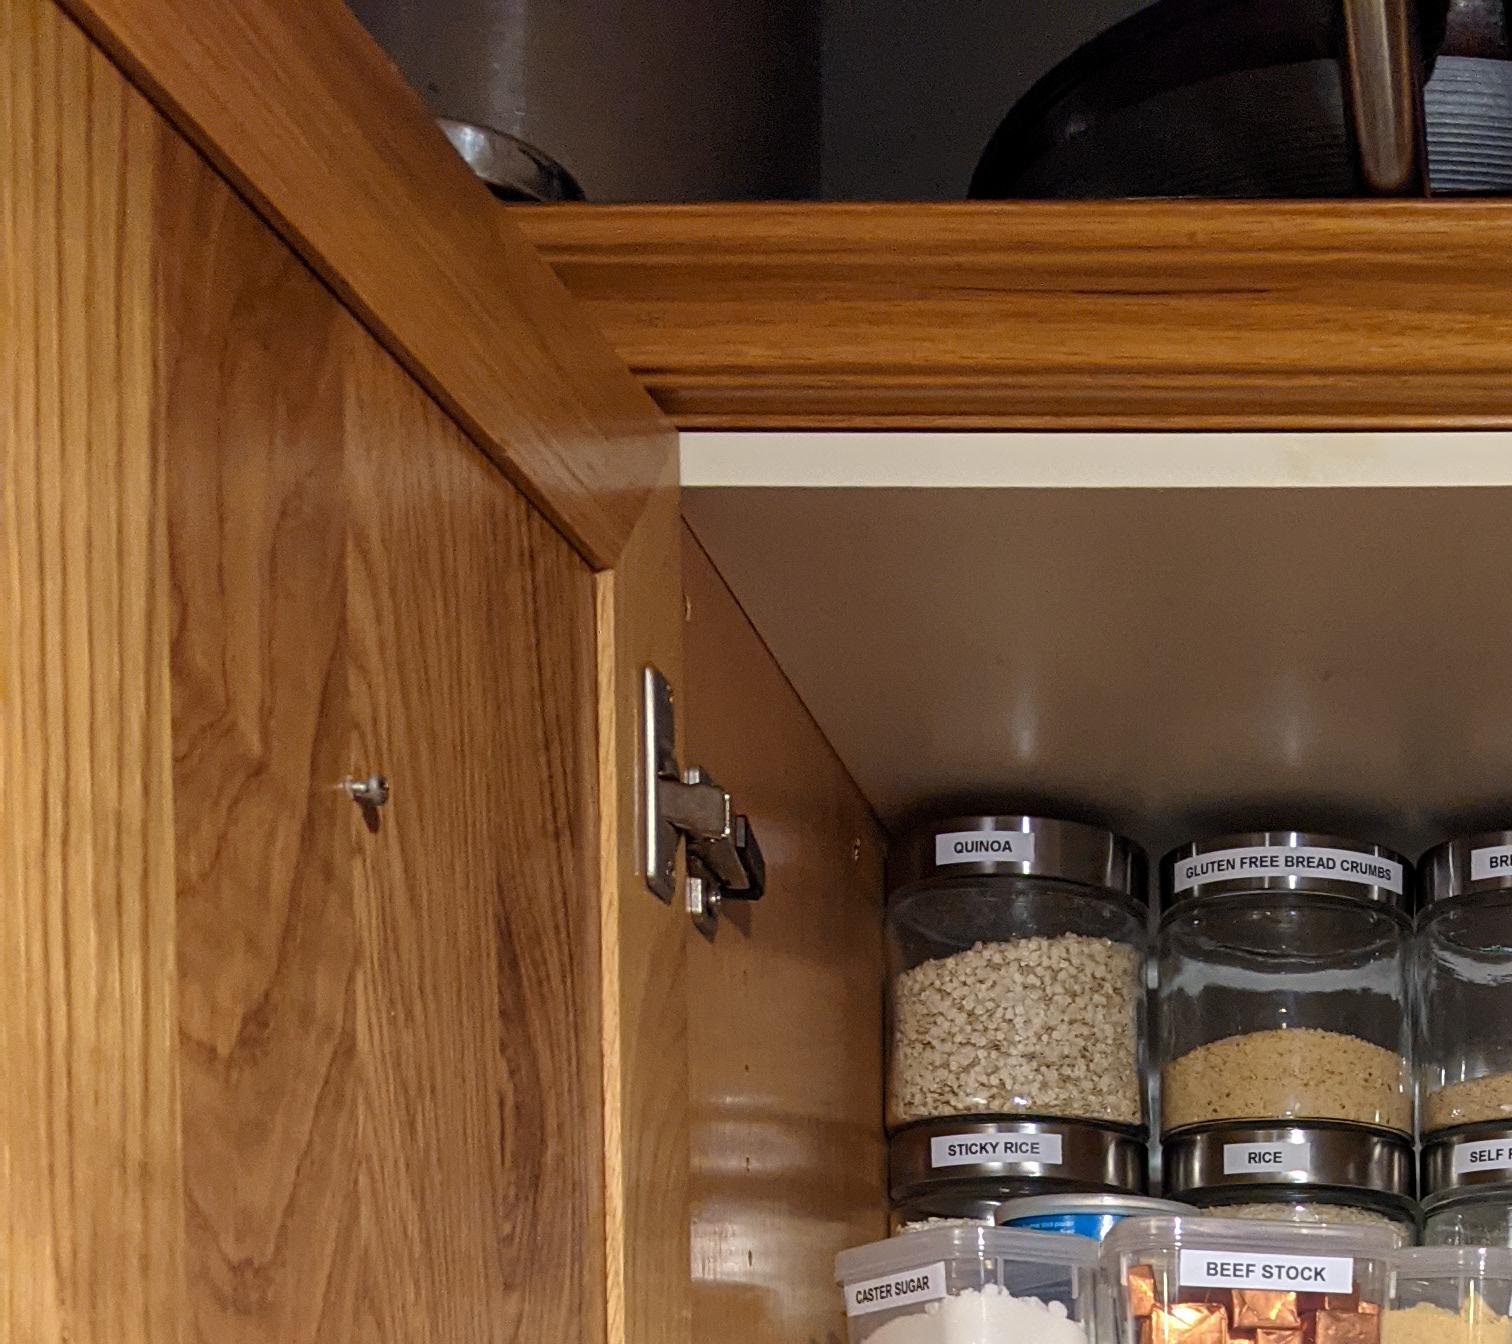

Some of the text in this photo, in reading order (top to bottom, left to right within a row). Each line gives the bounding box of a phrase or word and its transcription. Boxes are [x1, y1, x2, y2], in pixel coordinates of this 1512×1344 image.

[953, 840, 1013, 855] QUINOA
[1185, 855, 1392, 881] GLUTEN FREE BREAD CRUMBS
[948, 1140, 1040, 1157] STICKY RICE
[1469, 1147, 1504, 1163] SELF
[1247, 1151, 1283, 1164] RICE
[1206, 1261, 1326, 1282] BEEF STOCK
[856, 1276, 930, 1304] CASTER SUGAR
